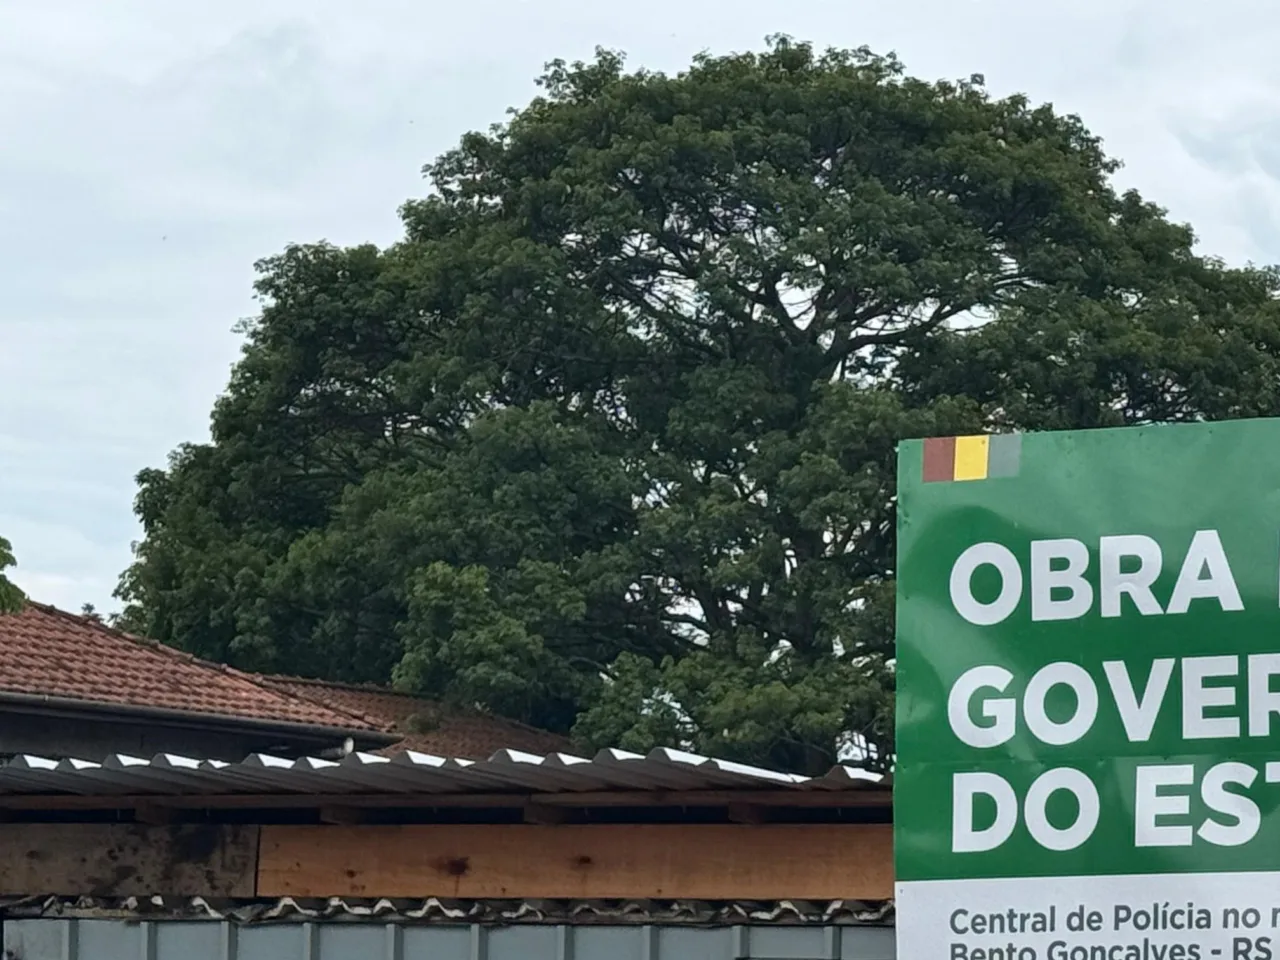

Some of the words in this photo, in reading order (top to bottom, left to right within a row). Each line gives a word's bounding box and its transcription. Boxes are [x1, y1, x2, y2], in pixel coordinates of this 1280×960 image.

[950, 530, 1244, 625] OBRA
[952, 768, 1099, 852] DO
[950, 906, 1055, 934] Central
[1067, 905, 1103, 931] de
[1114, 902, 1211, 930] Polícia
[1223, 908, 1260, 929] no
